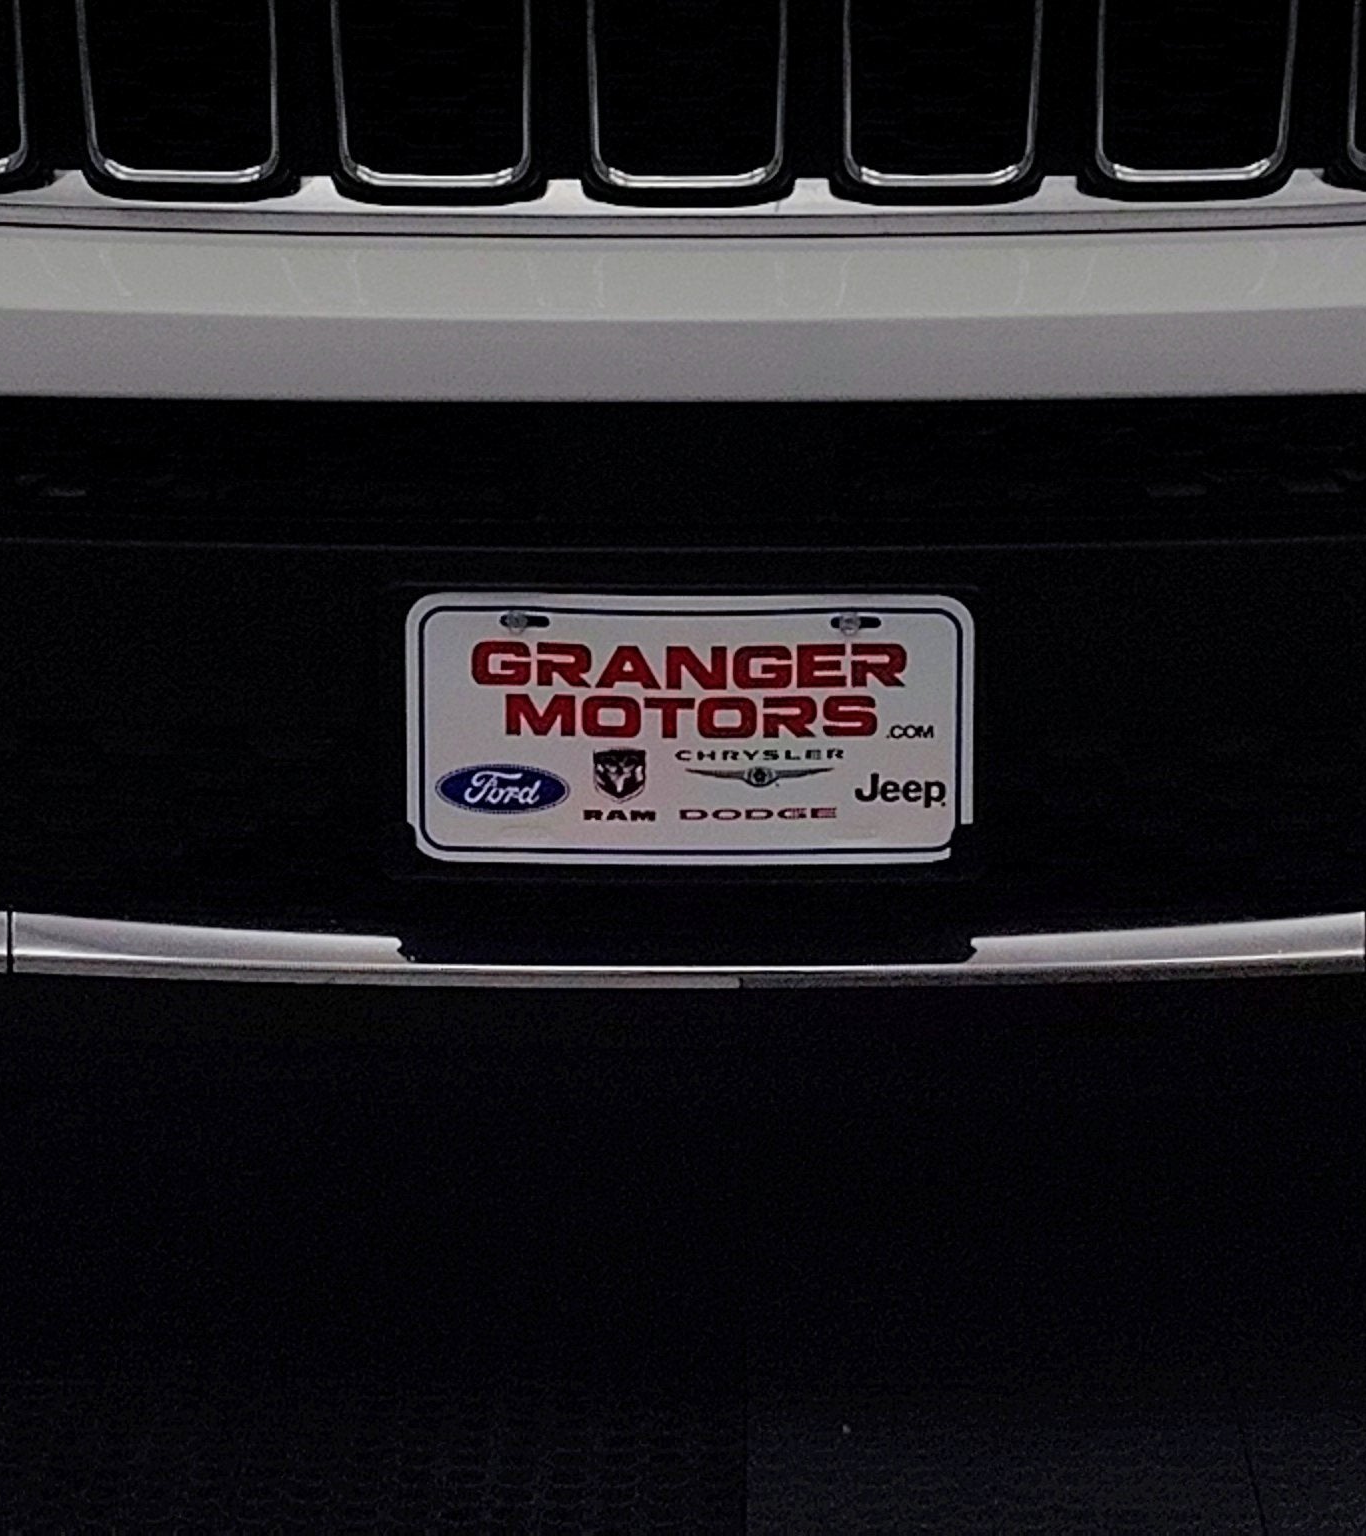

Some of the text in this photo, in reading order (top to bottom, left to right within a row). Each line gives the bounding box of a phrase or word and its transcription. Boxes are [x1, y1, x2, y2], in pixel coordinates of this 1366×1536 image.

[471, 640, 907, 690] GRANGER
[504, 693, 878, 739] MOTORS
[675, 749, 845, 761] CHRYSLER
[463, 770, 541, 806] Ford
[854, 773, 946, 808] Jeep
[583, 809, 656, 822] RAM
[678, 808, 838, 822] DODGE
